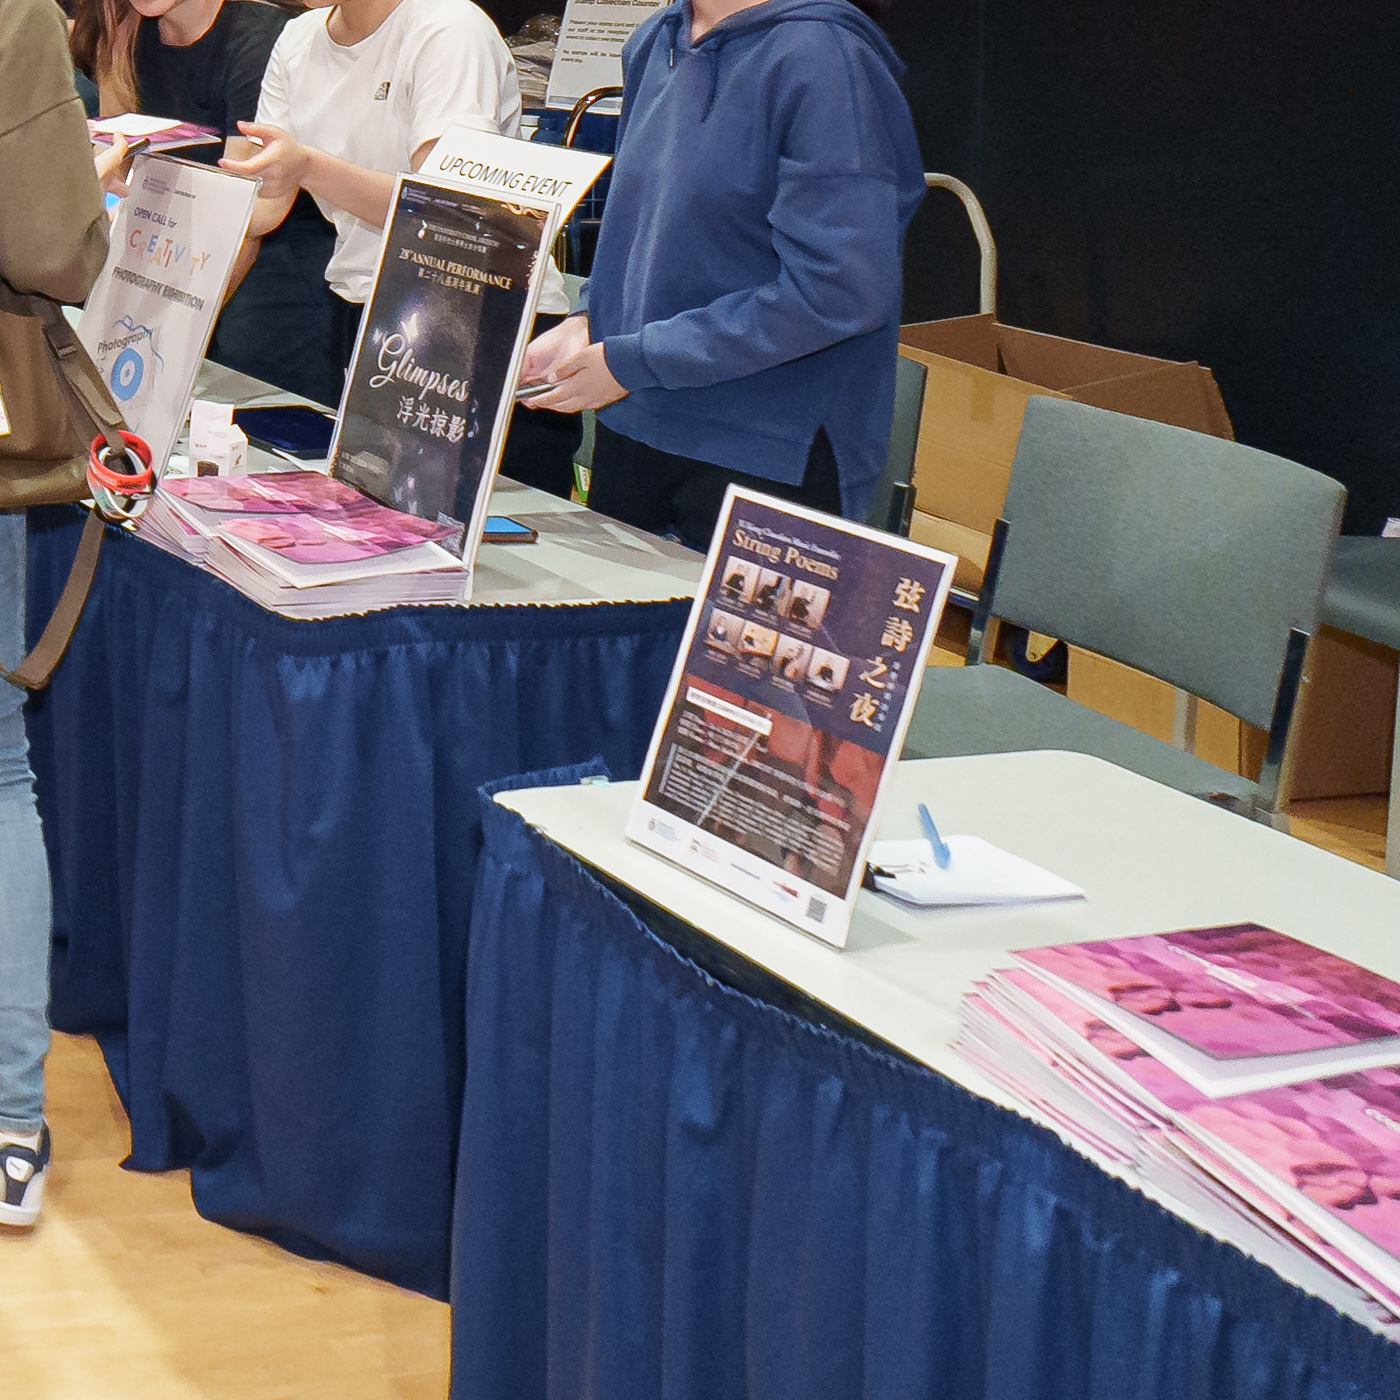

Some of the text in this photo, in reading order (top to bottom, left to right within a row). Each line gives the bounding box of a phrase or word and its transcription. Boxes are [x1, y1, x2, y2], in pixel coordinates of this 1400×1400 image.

[632, 0, 661, 8] Counter
[439, 154, 574, 198] UPCOMING EVENT
[134, 206, 178, 229] OPEN CALL for
[129, 229, 212, 277] CREATIVTY
[411, 252, 446, 272] ANNUAL
[446, 260, 513, 291] PERFORMANCE
[111, 266, 205, 311] PHOTOGRAPHY EXHIBITION
[97, 328, 153, 354] Photography
[369, 333, 470, 402] Glimpses
[396, 395, 467, 443] 浮光掠影
[732, 528, 782, 564] String
[784, 546, 840, 580] Poems
[850, 576, 927, 728] 弦詩之夜
